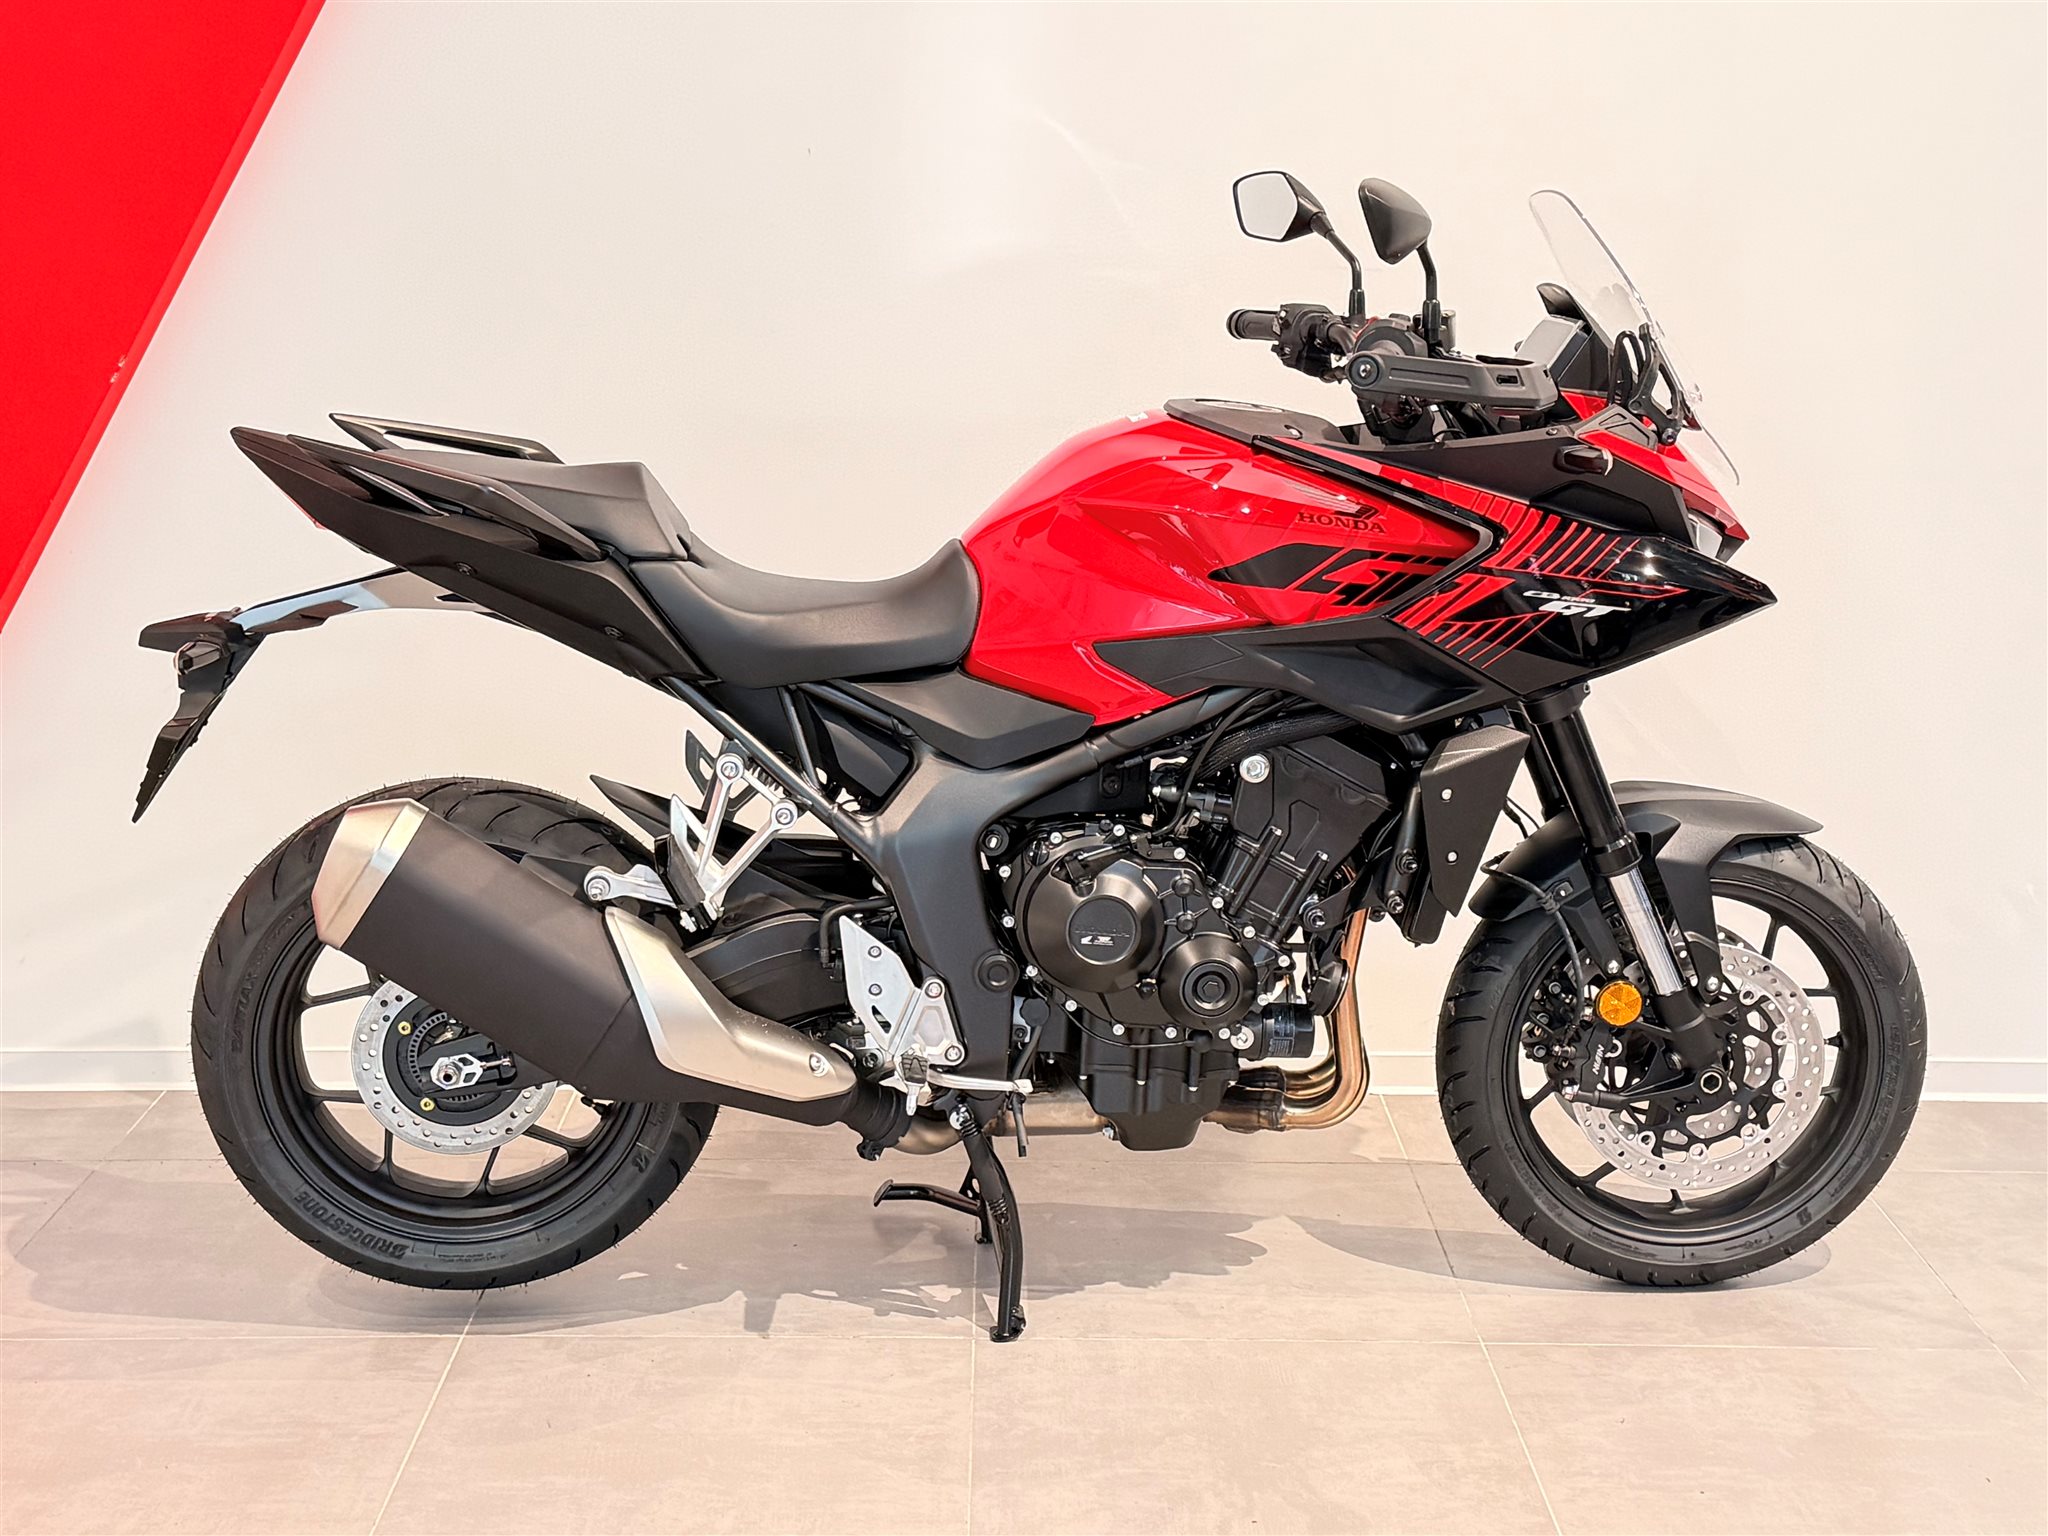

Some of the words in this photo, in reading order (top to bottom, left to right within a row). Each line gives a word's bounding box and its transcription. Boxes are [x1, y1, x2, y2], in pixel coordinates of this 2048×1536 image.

[1298, 511, 1386, 534] HONDA
[1538, 600, 1632, 618] GT
[294, 1191, 409, 1258] BRIDGESTONE
